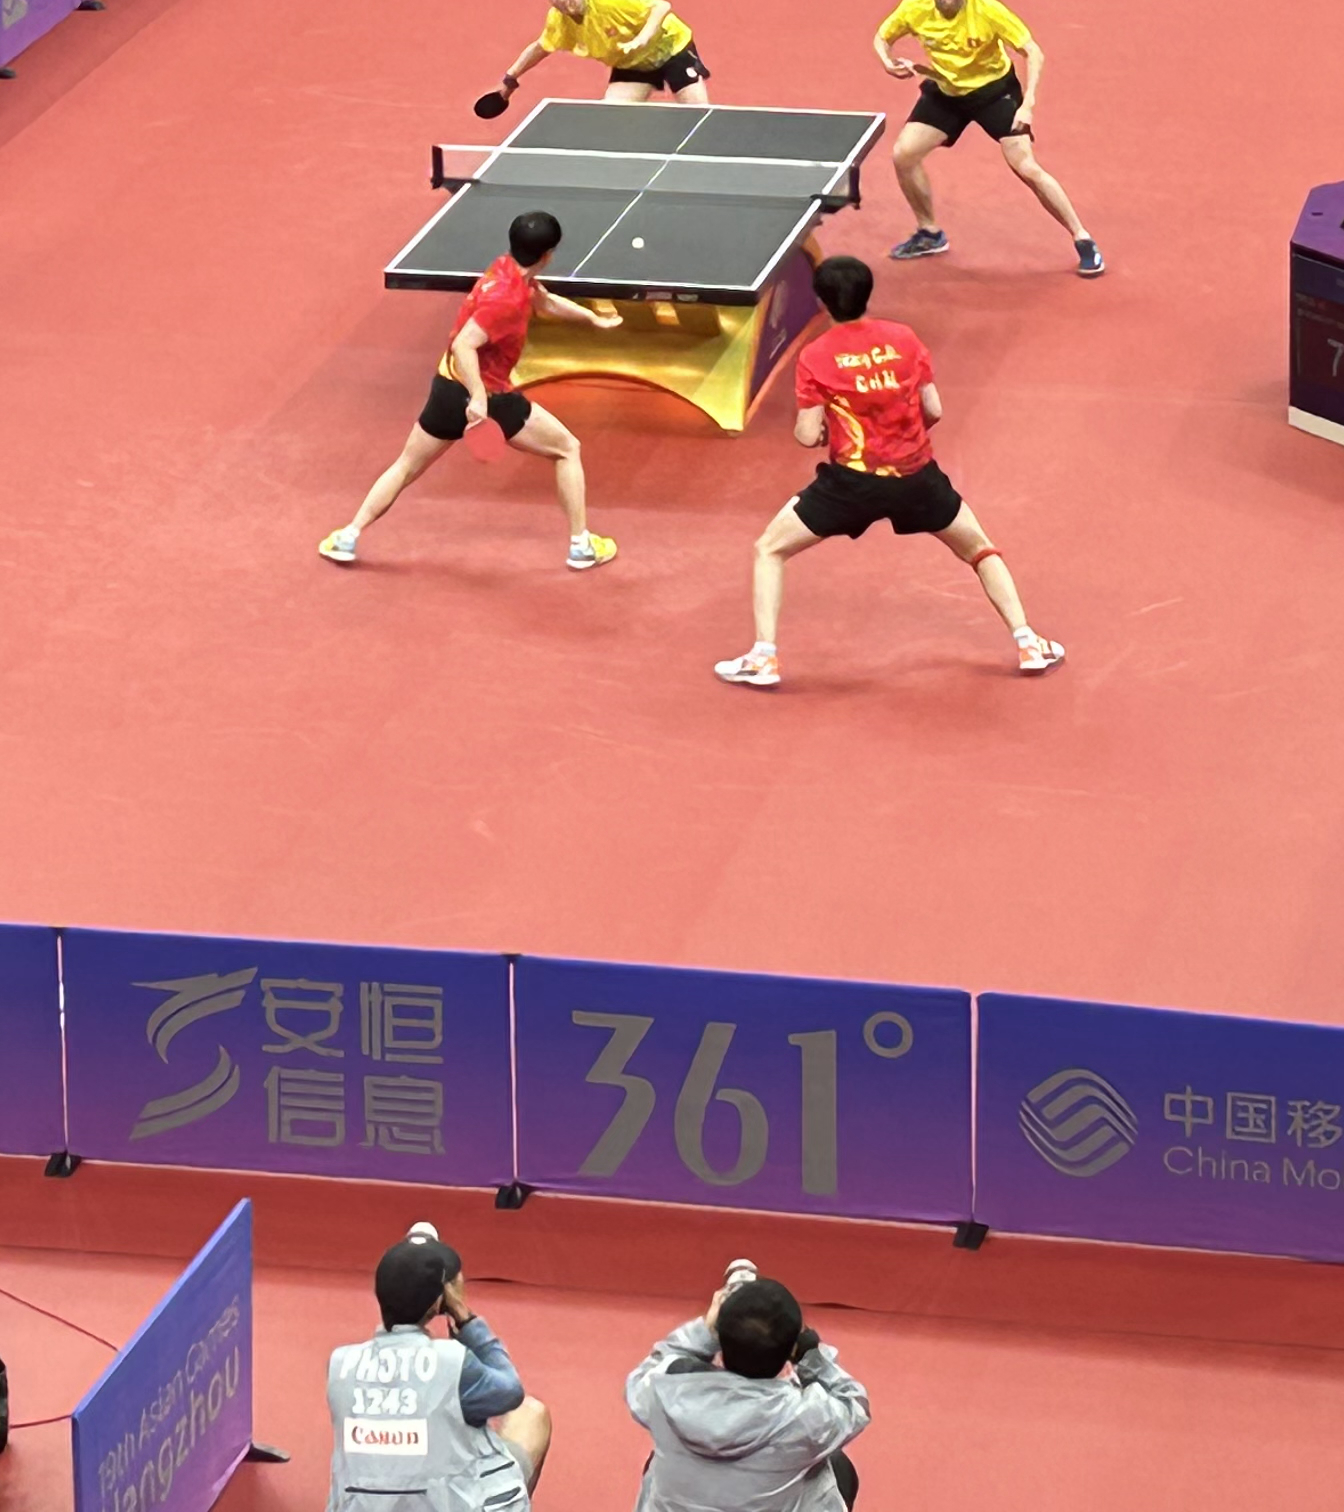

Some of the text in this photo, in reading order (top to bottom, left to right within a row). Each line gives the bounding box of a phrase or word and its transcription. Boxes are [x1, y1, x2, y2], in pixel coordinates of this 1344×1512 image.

[259, 977, 445, 1065] 安恒
[262, 1064, 447, 1156] 信息
[1162, 1145, 1272, 1185] China
[339, 1346, 439, 1383] PHOTO
[351, 1387, 419, 1416] 1243
